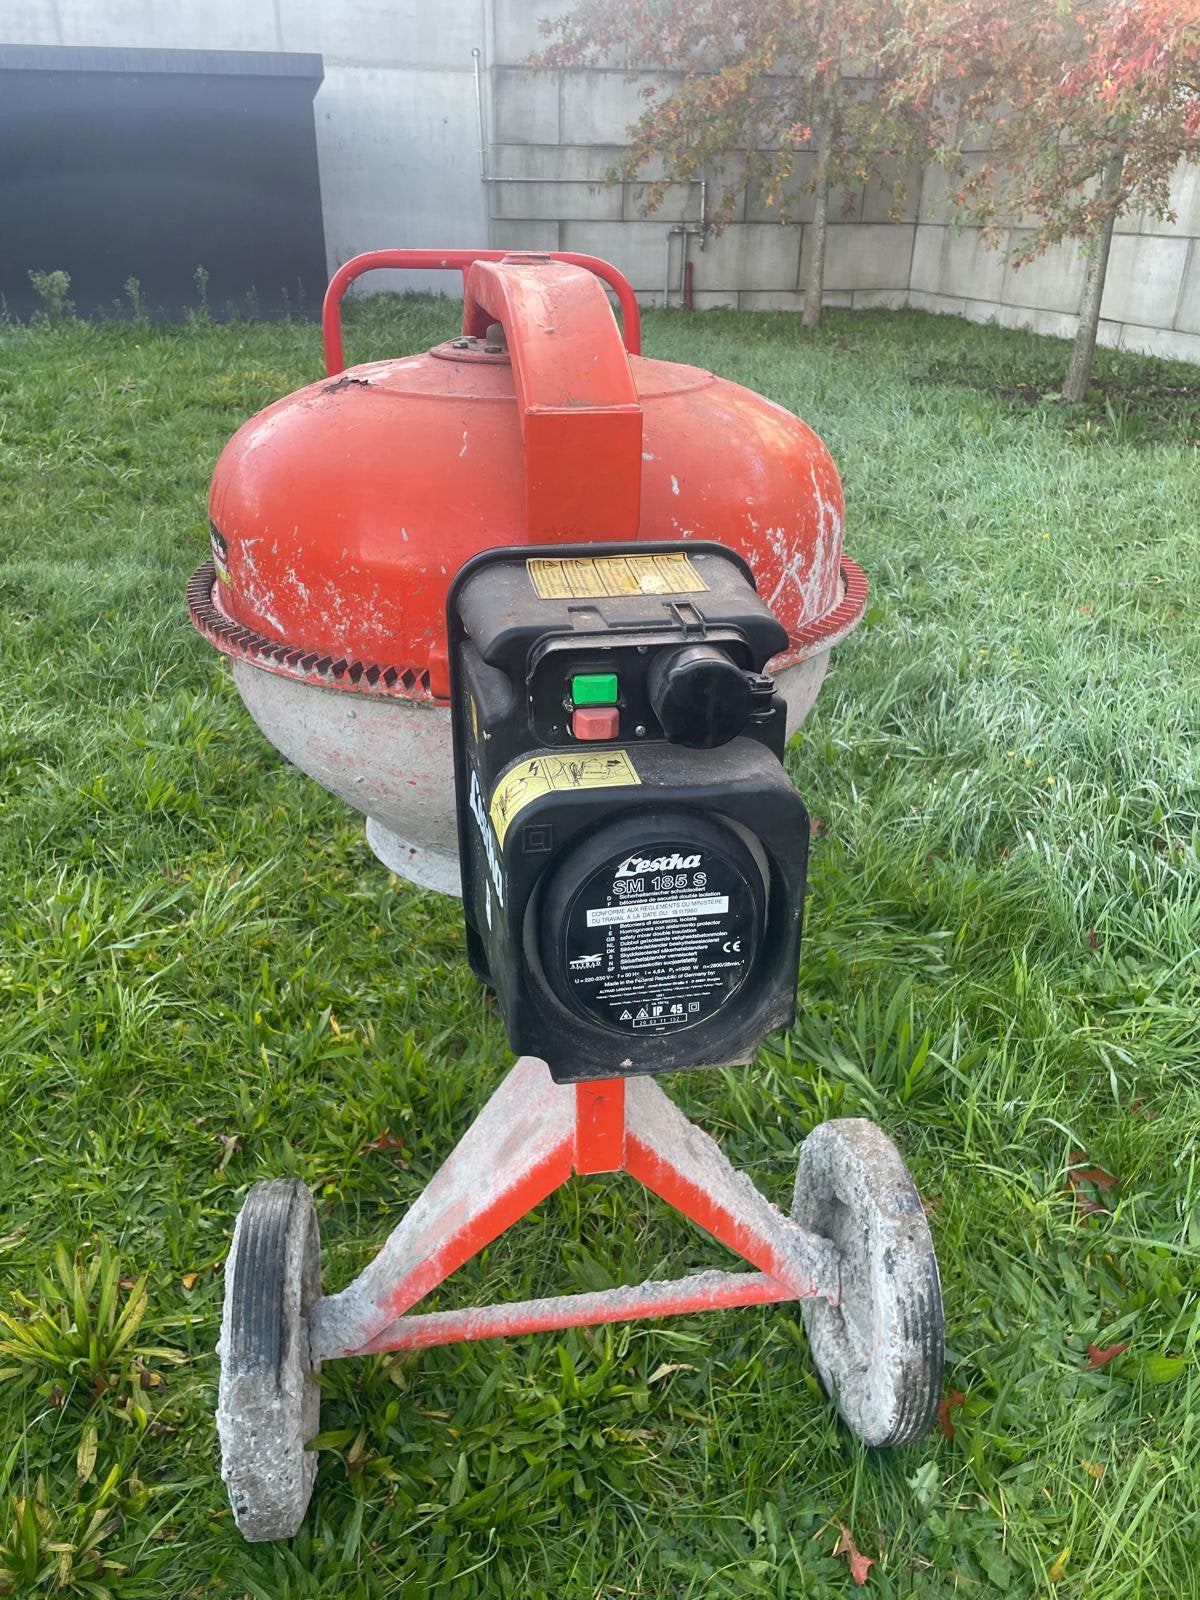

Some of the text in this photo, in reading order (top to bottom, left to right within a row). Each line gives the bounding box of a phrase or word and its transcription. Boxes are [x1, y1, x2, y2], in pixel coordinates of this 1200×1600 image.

[614, 854, 701, 878] Lescha
[613, 872, 707, 895] SM 185 S
[699, 890, 721, 898] isolation
[592, 908, 625, 917] CONFORME
[603, 915, 625, 923] TRAVAIL
[672, 927, 697, 935] insulation
[723, 940, 740, 954] CE
[684, 971, 707, 979] Germany
[653, 1005, 663, 1016] IP
[670, 1003, 683, 1014] 45
